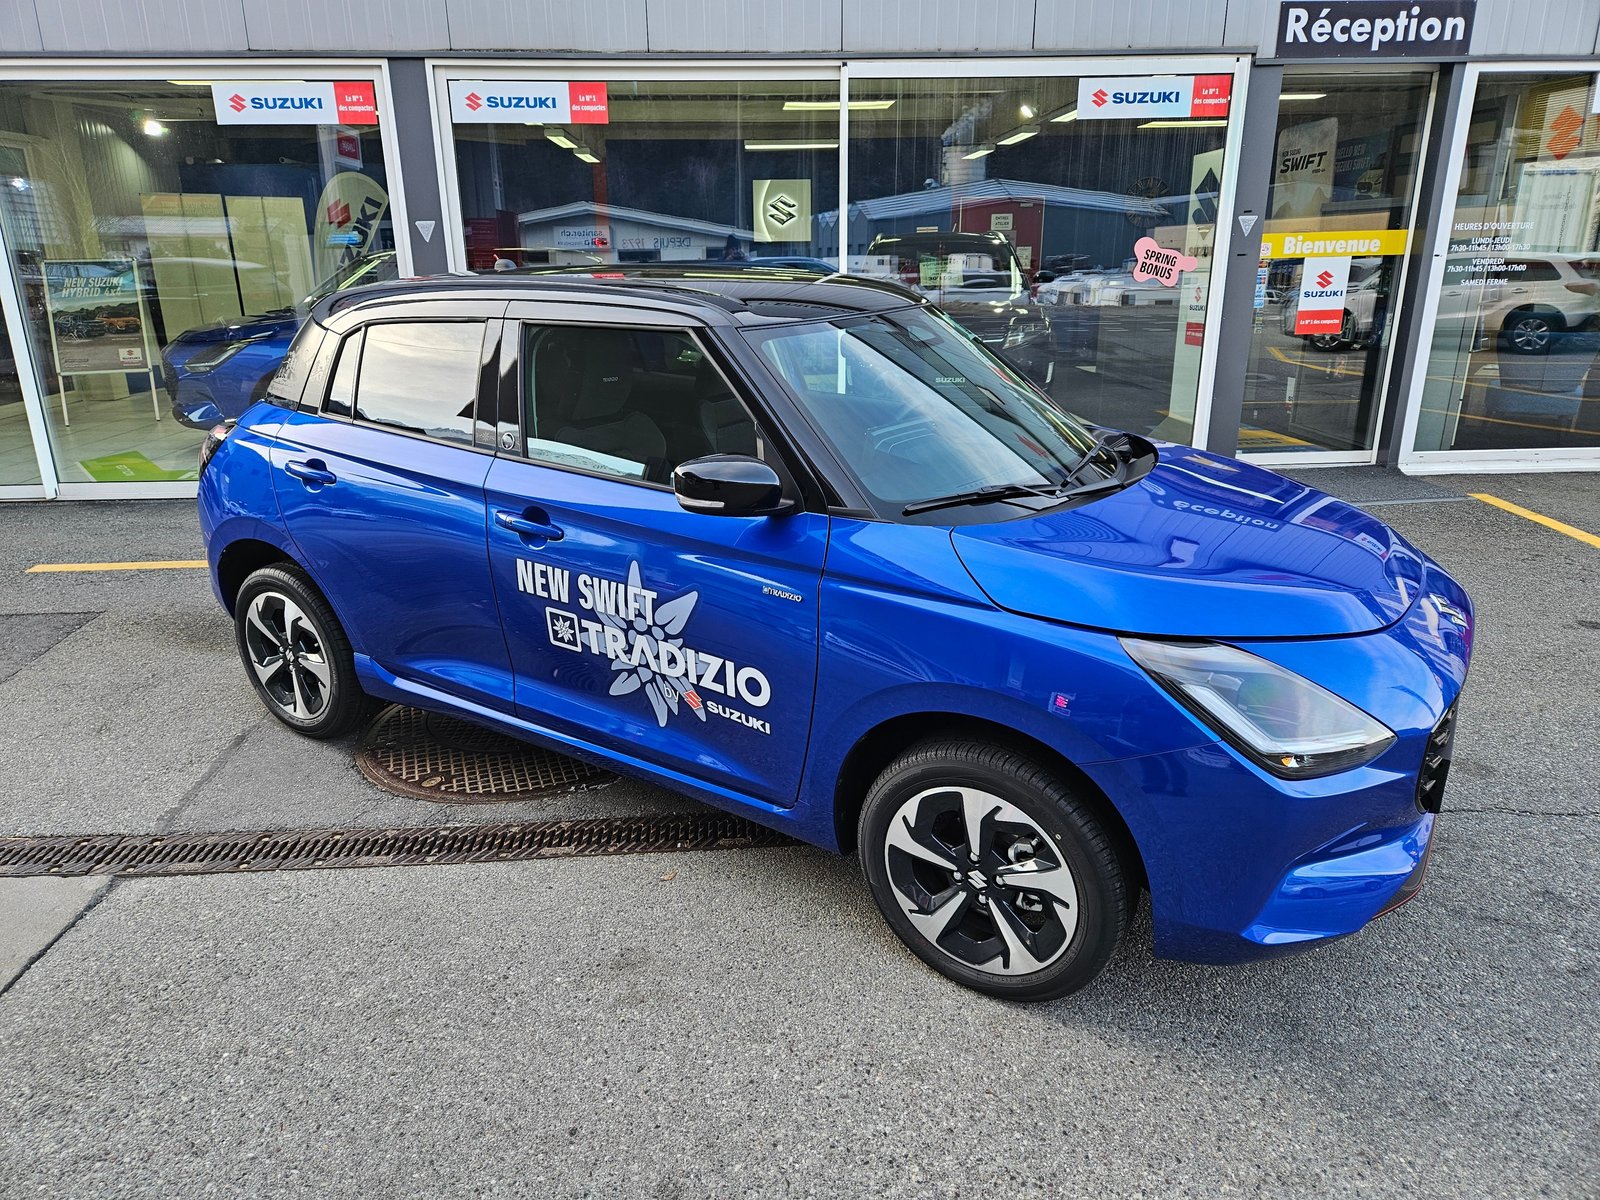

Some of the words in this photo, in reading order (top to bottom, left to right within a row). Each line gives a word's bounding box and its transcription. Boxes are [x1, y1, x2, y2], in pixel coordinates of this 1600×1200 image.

[1285, 6, 1466, 51] Réception
[250, 97, 323, 110] SUZUKI
[486, 96, 557, 109] SUZUKI
[1112, 91, 1180, 105] SUZUKI
[1203, 97, 1227, 105] compactes
[348, 104, 374, 112] compactes
[572, 103, 581, 111] des
[581, 103, 606, 112] compactes
[1280, 151, 1328, 173] SWIFT
[1454, 222, 1483, 231] HEURES
[1483, 221, 1535, 230] D'OUVERTURE
[1283, 235, 1381, 255] Bienvenue
[1144, 249, 1178, 267] SPRING
[1140, 261, 1173, 280] BONUS
[64, 277, 87, 288] NEW
[88, 276, 124, 287] SUZUKI
[61, 287, 101, 298] HYBRID
[1303, 290, 1344, 298] SUZUKI
[516, 558, 570, 604] NEW
[577, 573, 658, 626] SWIFT
[768, 586, 802, 602] TRADIZIO
[580, 619, 771, 707] TRADIZIO
[662, 684, 680, 703] by
[706, 700, 771, 735] SUZUKI
